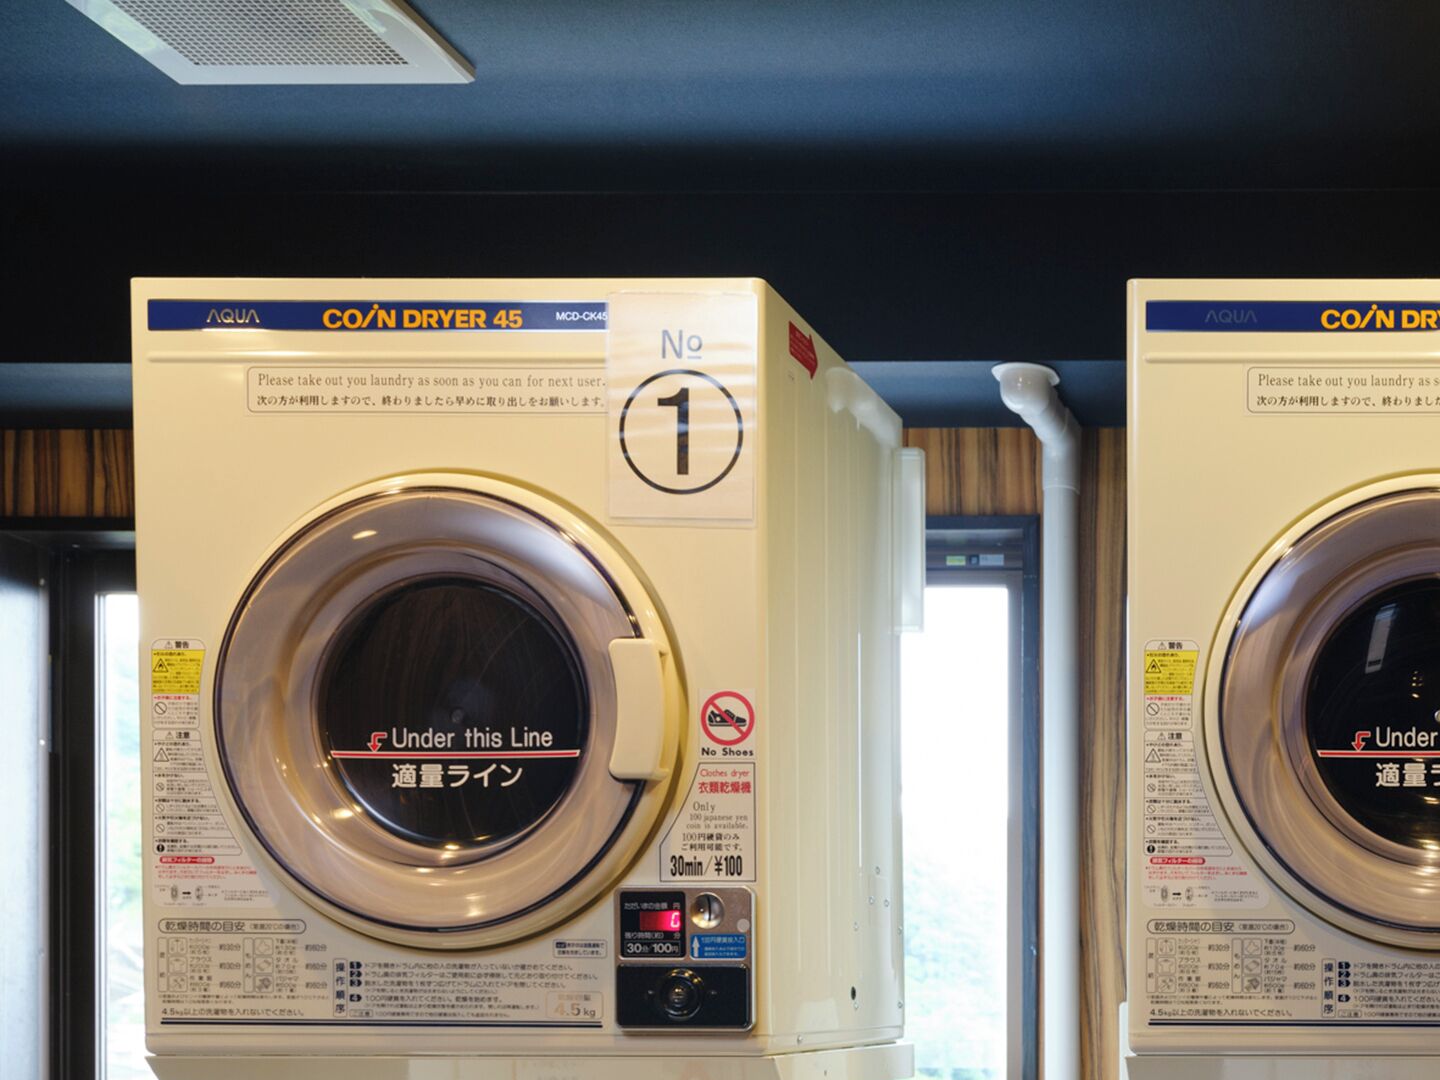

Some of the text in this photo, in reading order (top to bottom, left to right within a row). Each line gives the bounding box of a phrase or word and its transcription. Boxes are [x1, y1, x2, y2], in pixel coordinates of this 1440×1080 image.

[206, 309, 260, 323] AQUA
[403, 309, 486, 328] DRYER
[493, 310, 523, 328] 45
[1205, 310, 1257, 323] AQUA
[258, 374, 606, 389] Please take out you laundry as soon as you can for next user.
[1258, 374, 1293, 386] Please
[1298, 374, 1321, 386] take
[1325, 376, 1343, 386] out
[1347, 377, 1367, 389] you
[1371, 374, 1414, 389] laundry
[1418, 377, 1430, 386] as
[392, 727, 553, 748] Under this Line
[1375, 726, 1438, 747] Under
[701, 747, 754, 757] No Shoes
[392, 764, 522, 788] 適量ライン
[700, 769, 750, 779] Clothes dryer
[698, 781, 751, 794] 衣類乾燥機
[693, 802, 716, 812] Only
[165, 921, 245, 931] 乾燥時間の目安
[1154, 921, 1234, 932] 乾燥時間の目安
